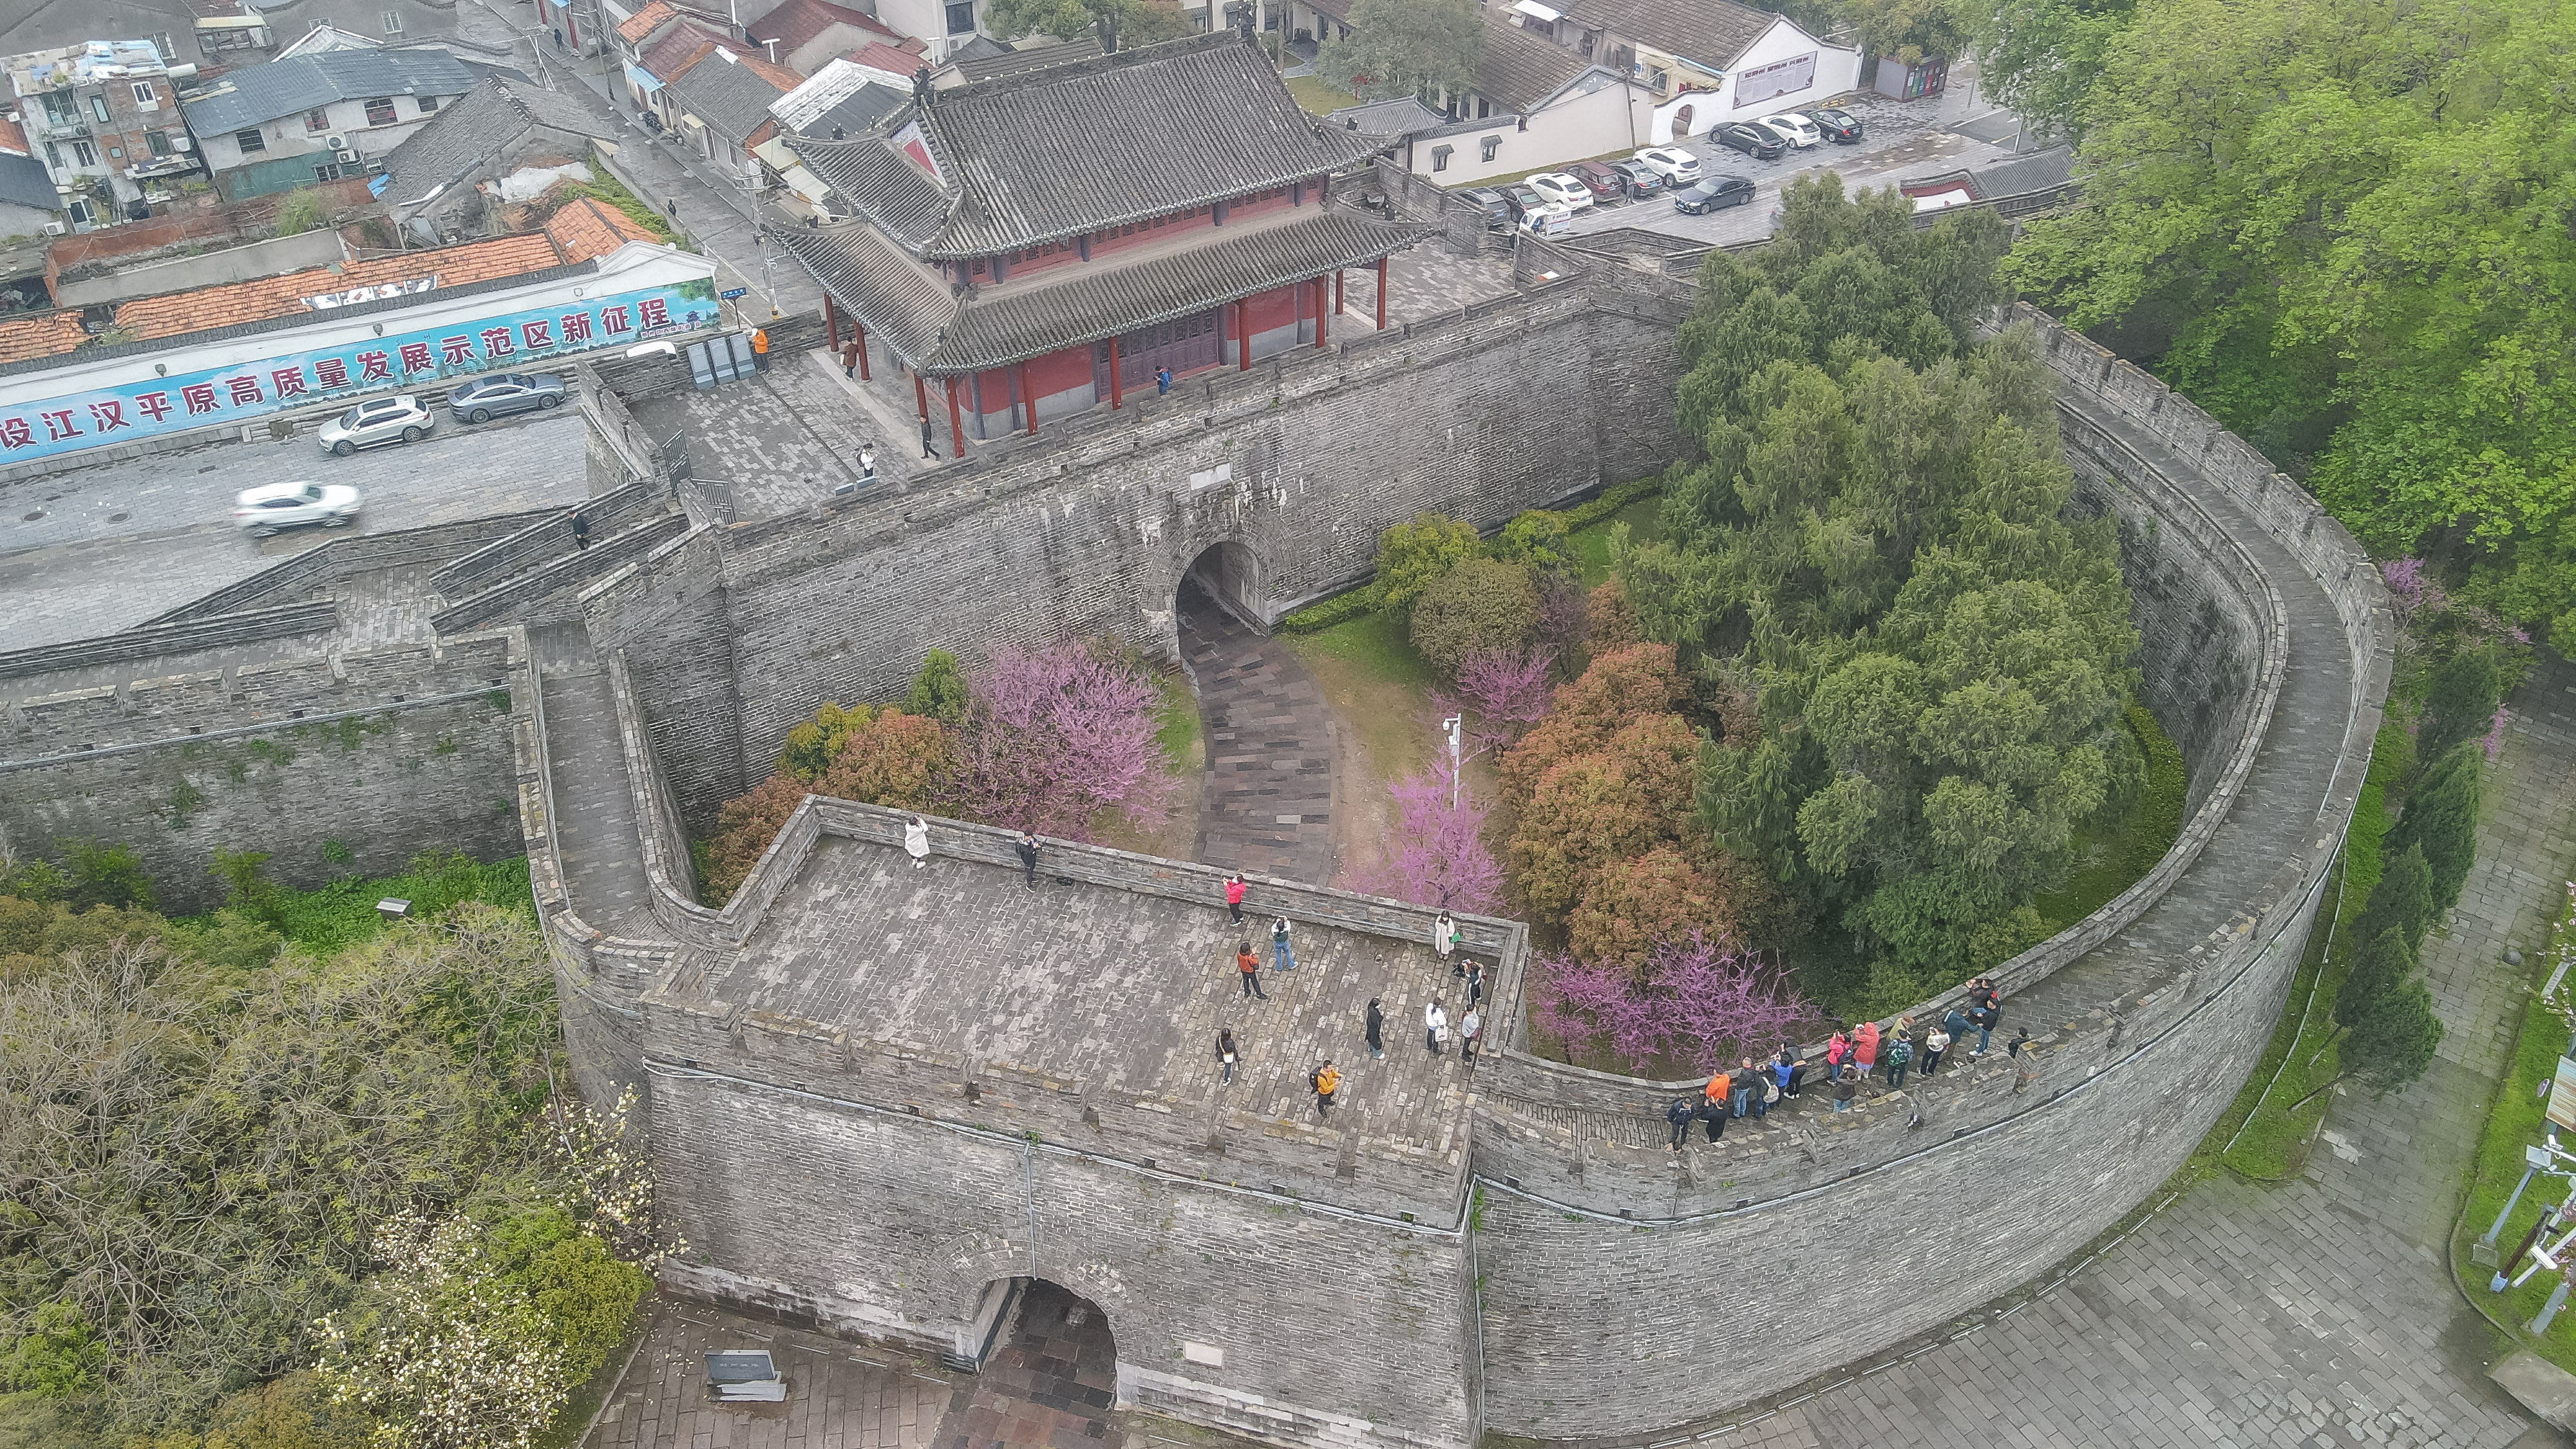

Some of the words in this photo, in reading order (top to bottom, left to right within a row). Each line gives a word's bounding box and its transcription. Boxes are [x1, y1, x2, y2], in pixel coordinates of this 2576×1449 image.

[0, 298, 670, 449] 设江汉平原高质量发展示范区新征程
